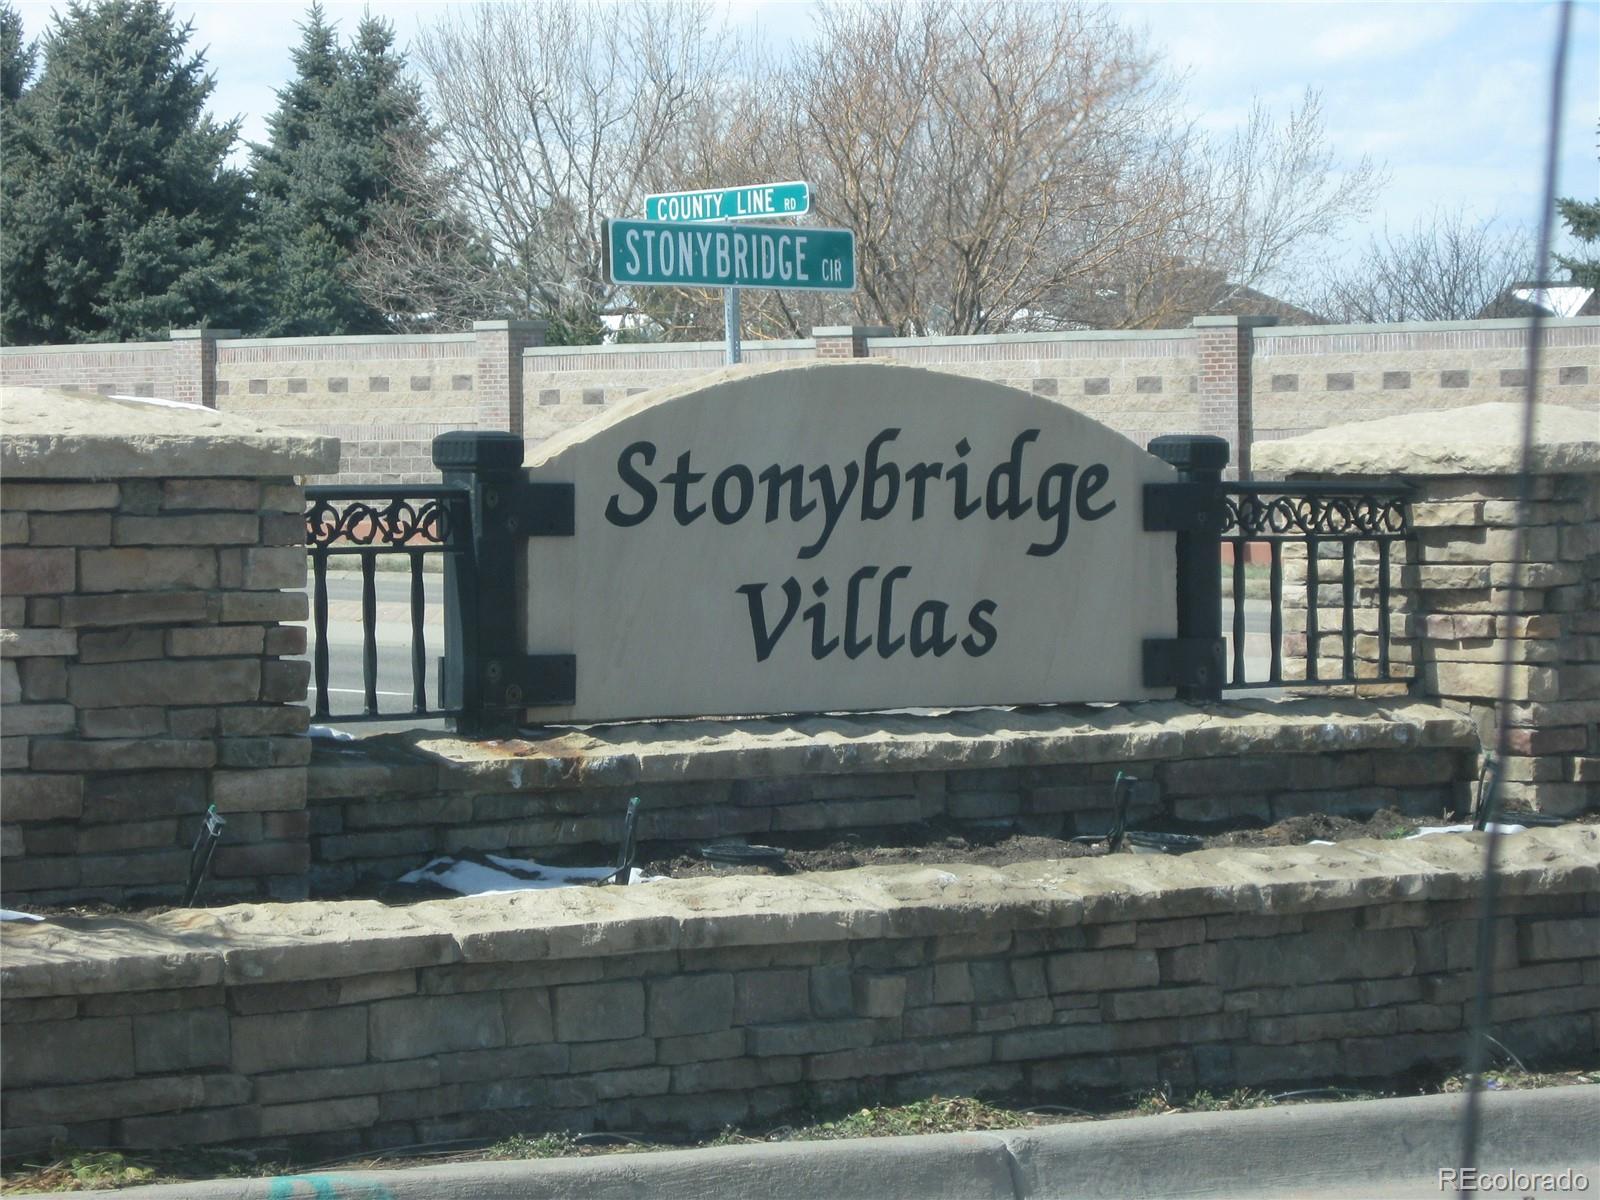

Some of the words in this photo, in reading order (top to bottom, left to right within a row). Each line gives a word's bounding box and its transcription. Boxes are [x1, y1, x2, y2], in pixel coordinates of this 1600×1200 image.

[657, 193, 724, 221] COUNTY
[737, 188, 775, 214] LINE
[784, 197, 797, 211] RD
[625, 228, 809, 281] STONYBRIDGE
[821, 258, 843, 282] CIR
[604, 428, 1117, 560] Stonybridge
[735, 565, 998, 663] Villas
